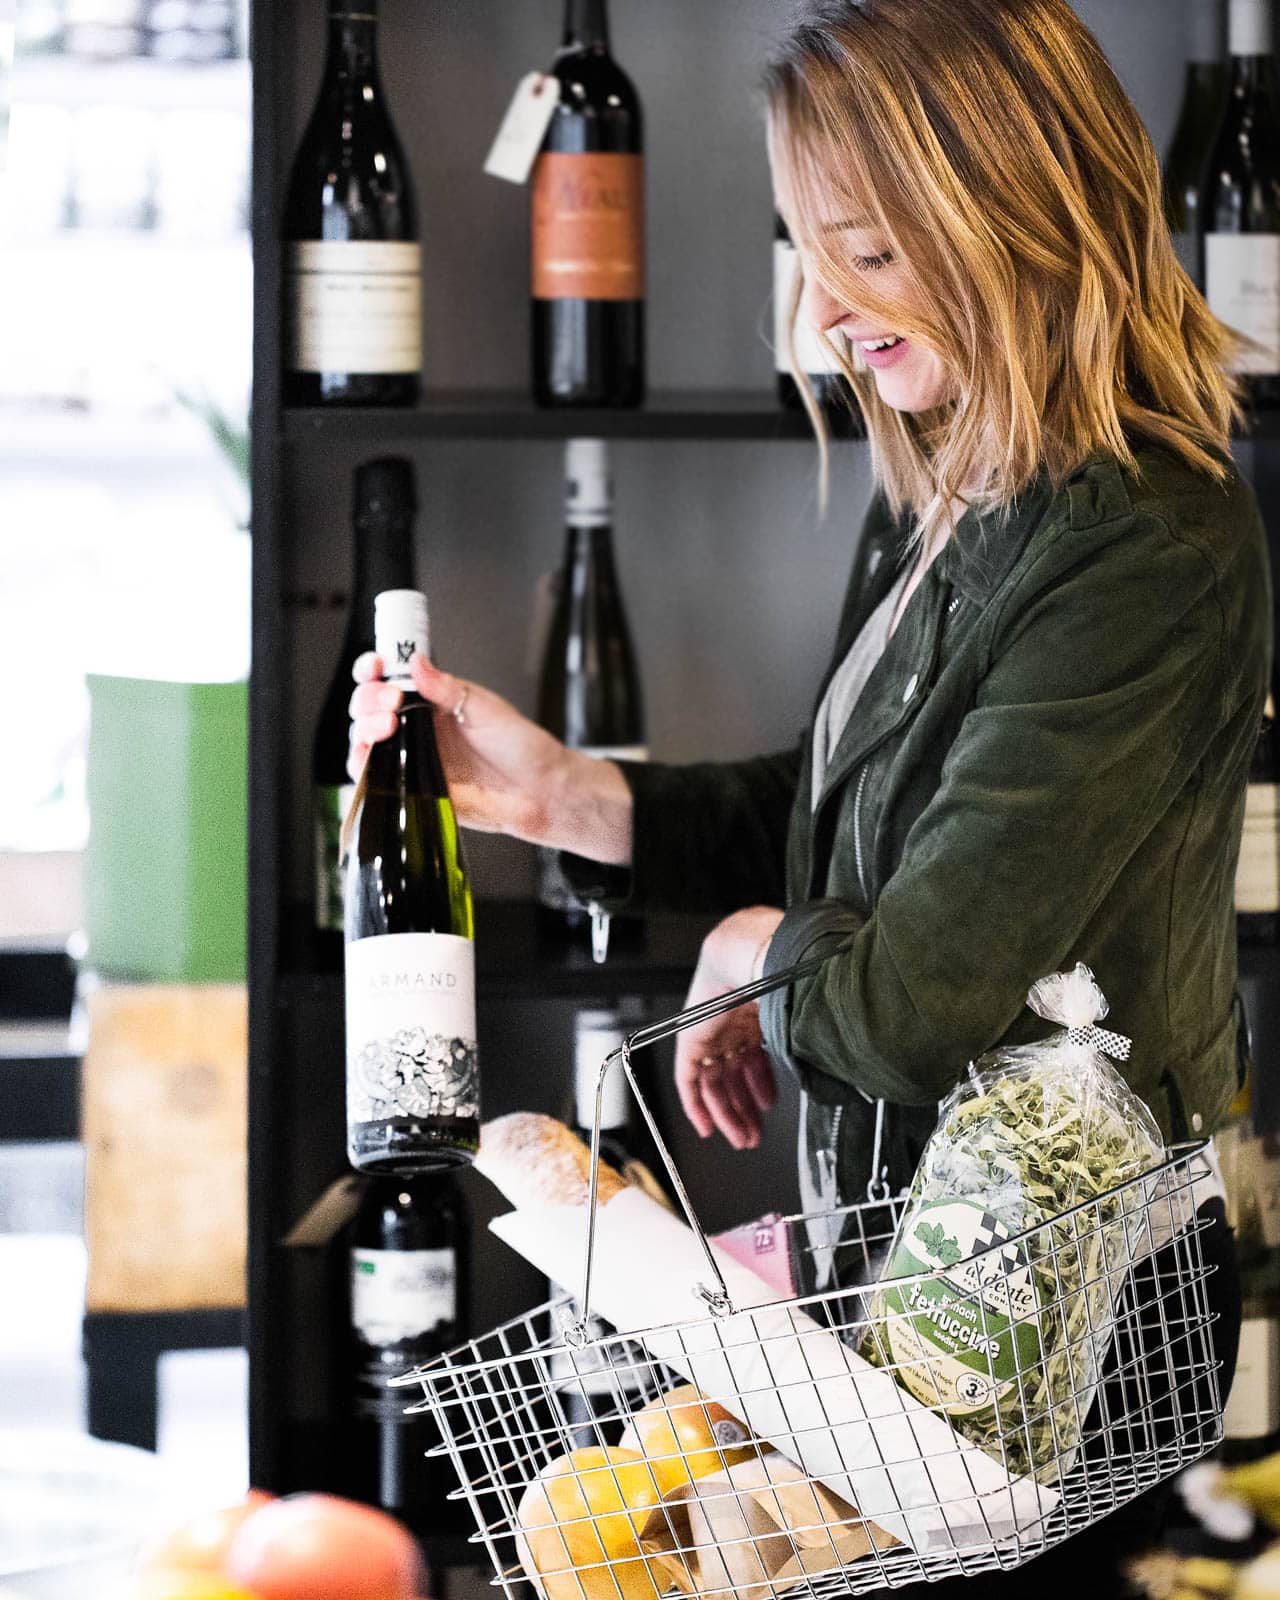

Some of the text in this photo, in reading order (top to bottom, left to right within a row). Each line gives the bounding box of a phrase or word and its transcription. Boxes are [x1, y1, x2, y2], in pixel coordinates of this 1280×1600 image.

[368, 972, 457, 989] ARMAND
[984, 1272, 1034, 1306] dente
[988, 1293, 1028, 1313] COMANY
[909, 1282, 1001, 1360] fettuccine
[965, 1383, 979, 1398] 3
